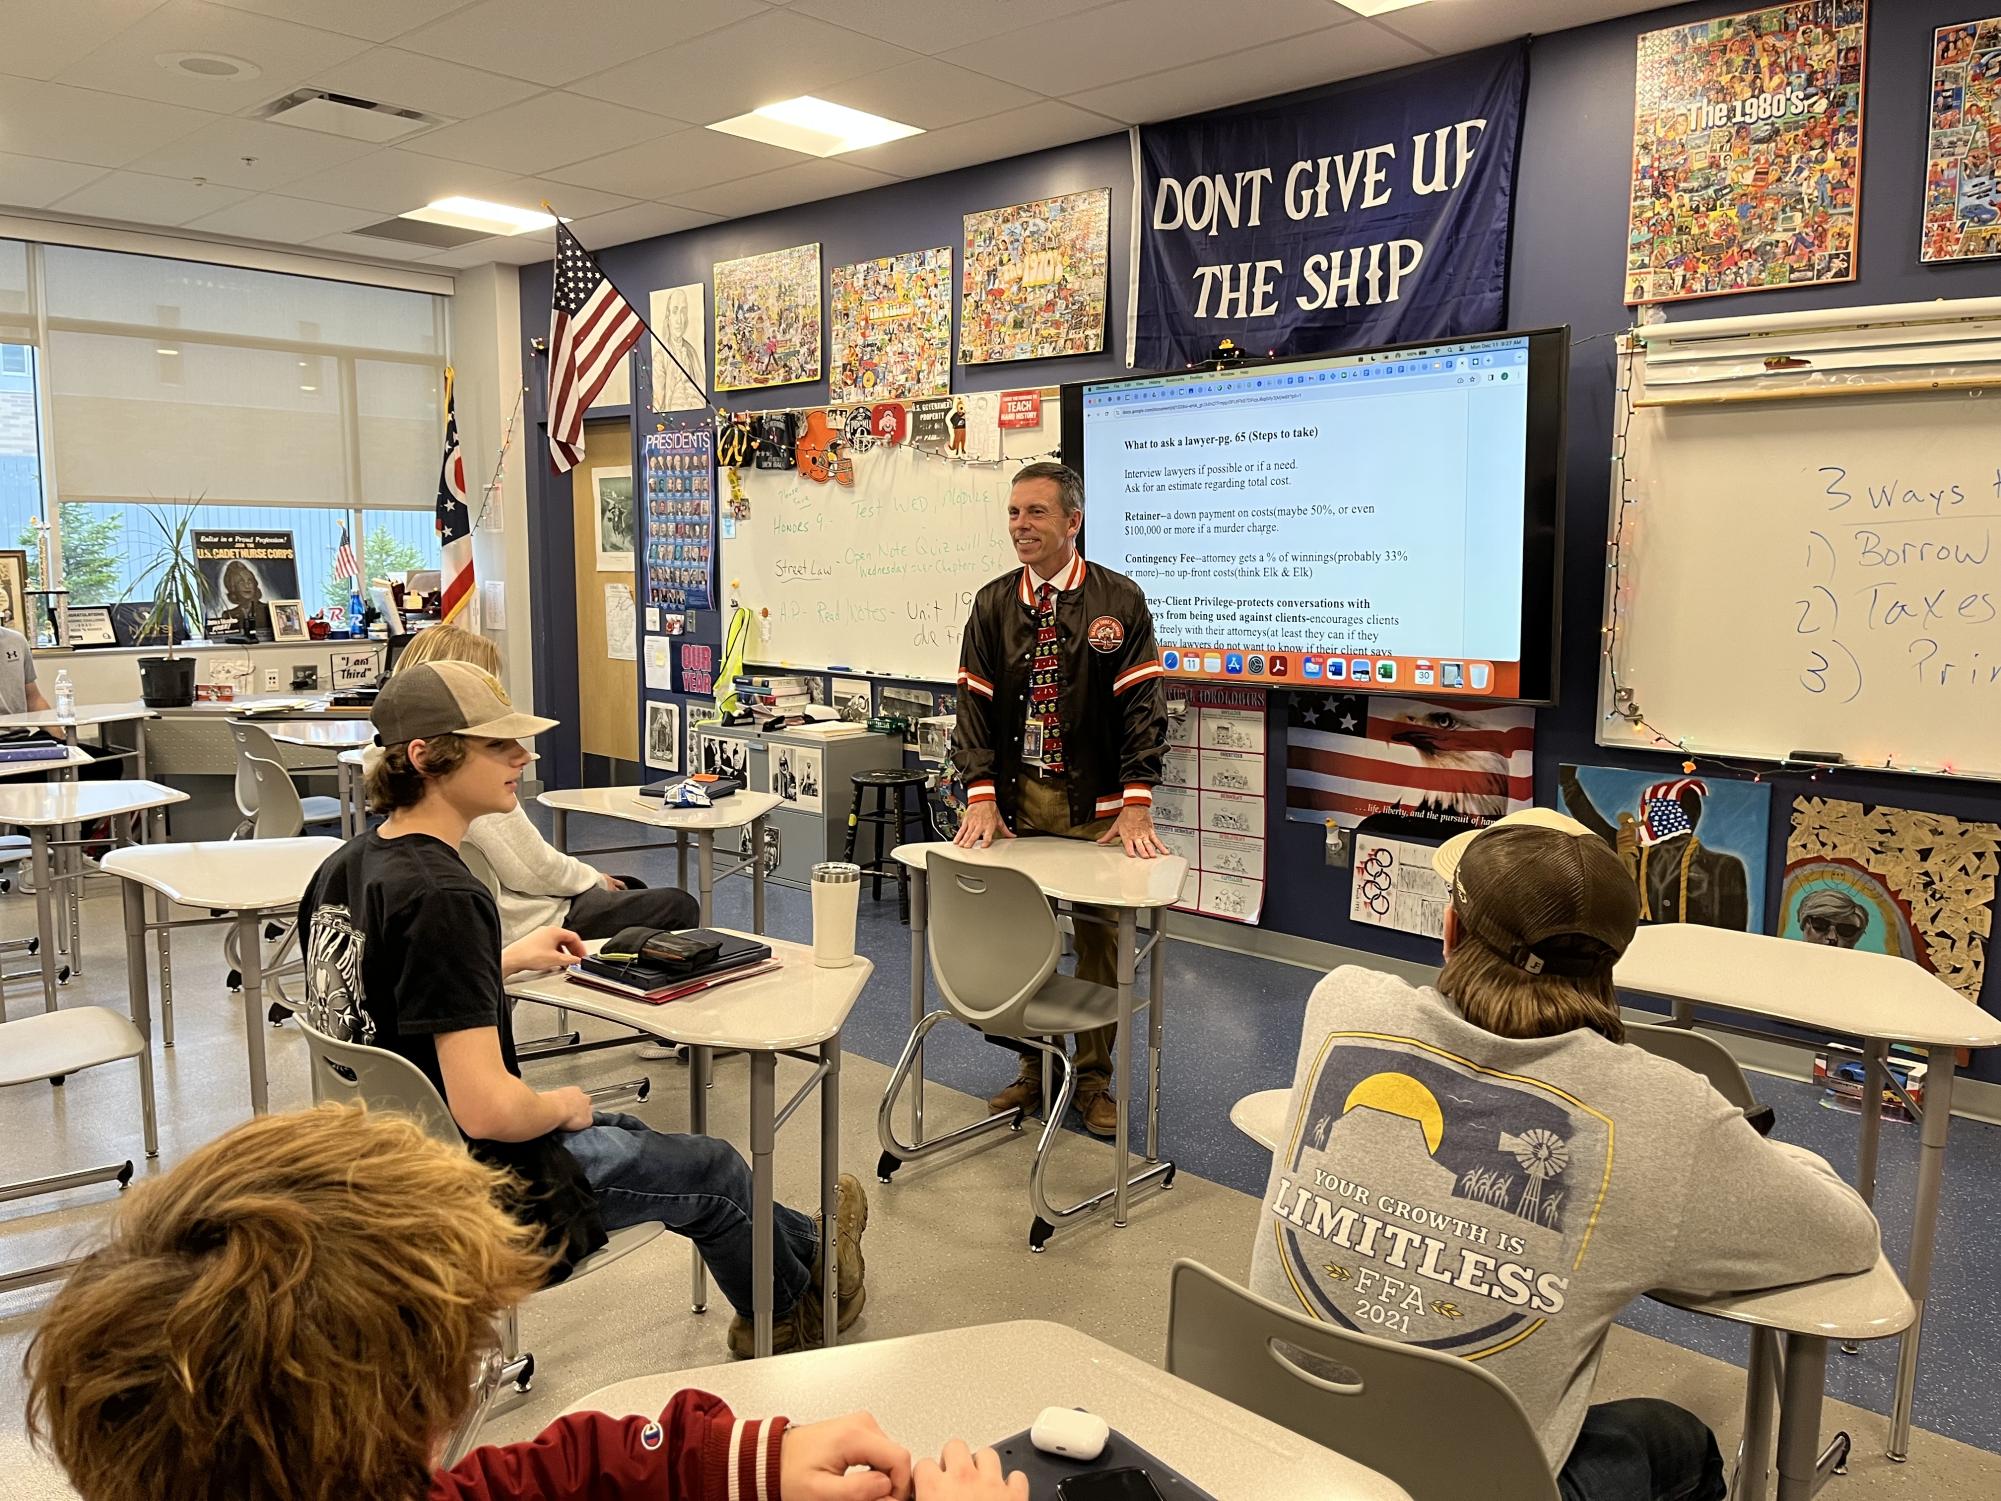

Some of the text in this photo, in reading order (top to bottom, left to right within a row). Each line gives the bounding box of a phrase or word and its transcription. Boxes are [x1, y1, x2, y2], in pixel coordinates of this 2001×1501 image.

[1688, 86, 1804, 130] The 1980's
[1153, 118, 1487, 236] DONT GIVE UP
[1192, 238, 1424, 319] THE SHIP
[1008, 401, 1032, 412] TEACH
[646, 432, 710, 449] PRESIDENTS
[1124, 426, 1318, 450] What to ask a lawyer-pg. 65 (Steps to take)
[1124, 459, 1298, 479] Interview lawyers if possible or if a need.
[1124, 476, 1292, 494] Ask for an estimate regarding total cost.
[1818, 466, 1852, 510] 3
[1174, 504, 1375, 522] down payment on costs(maybe 50%, or even
[1125, 522, 1279, 536] $100,000 or more if a murder charge.
[213, 548, 240, 559] CADET
[241, 548, 268, 558] NURSE
[268, 548, 294, 559] CORPS
[1125, 550, 1408, 565] Contingency gets a % of winnings(probably 33%
[1806, 528, 1990, 582] 1) Borrow
[1178, 568, 1211, 579] up-front
[1214, 568, 1261, 579] costs(think
[1263, 568, 1278, 578] Elk
[1282, 568, 1290, 578] &
[1293, 567, 1312, 578] Elk)
[906, 600, 943, 622] Unit
[1194, 596, 1370, 609] Privilege-protects conversations with
[1796, 582, 1996, 634] 2) Taxes
[328, 608, 345, 620] R
[351, 614, 363, 626] R
[1166, 610, 1187, 620] from
[1190, 611, 1214, 622] being
[1216, 612, 1236, 621] used
[1240, 612, 1272, 624] against
[1276, 614, 1363, 626] clients-encourages
[1366, 614, 1399, 626] clients
[914, 623, 939, 647] due
[1160, 625, 1182, 636] freely
[1185, 626, 1204, 635] with
[1206, 626, 1228, 636] their
[1231, 627, 1278, 638] attorneys(at
[1282, 629, 1302, 638] least
[1305, 629, 1324, 640] they
[1328, 631, 1344, 640] can
[1348, 630, 1356, 640] if
[1358, 630, 1378, 642] they
[1156, 638, 1392, 656] Many lawyers do not want to know if their client says
[354, 658, 369, 666] am
[682, 644, 712, 672] OUR
[1186, 659, 1196, 669] 11
[1419, 671, 1430, 680] 30
[1800, 639, 1862, 704] 3)
[682, 670, 712, 694] YEAR
[1382, 806, 1409, 818] liberty,
[1410, 810, 1424, 818] and
[1426, 811, 1439, 820] the
[1440, 812, 1468, 824] pursuit
[1470, 816, 1480, 826] of
[1314, 1168, 1526, 1256] YOUR GROWTH IS
[1271, 1177, 1570, 1315] LIMITLESS
[1354, 1266, 1426, 1317] FFA
[1354, 1300, 1411, 1335] 2021
